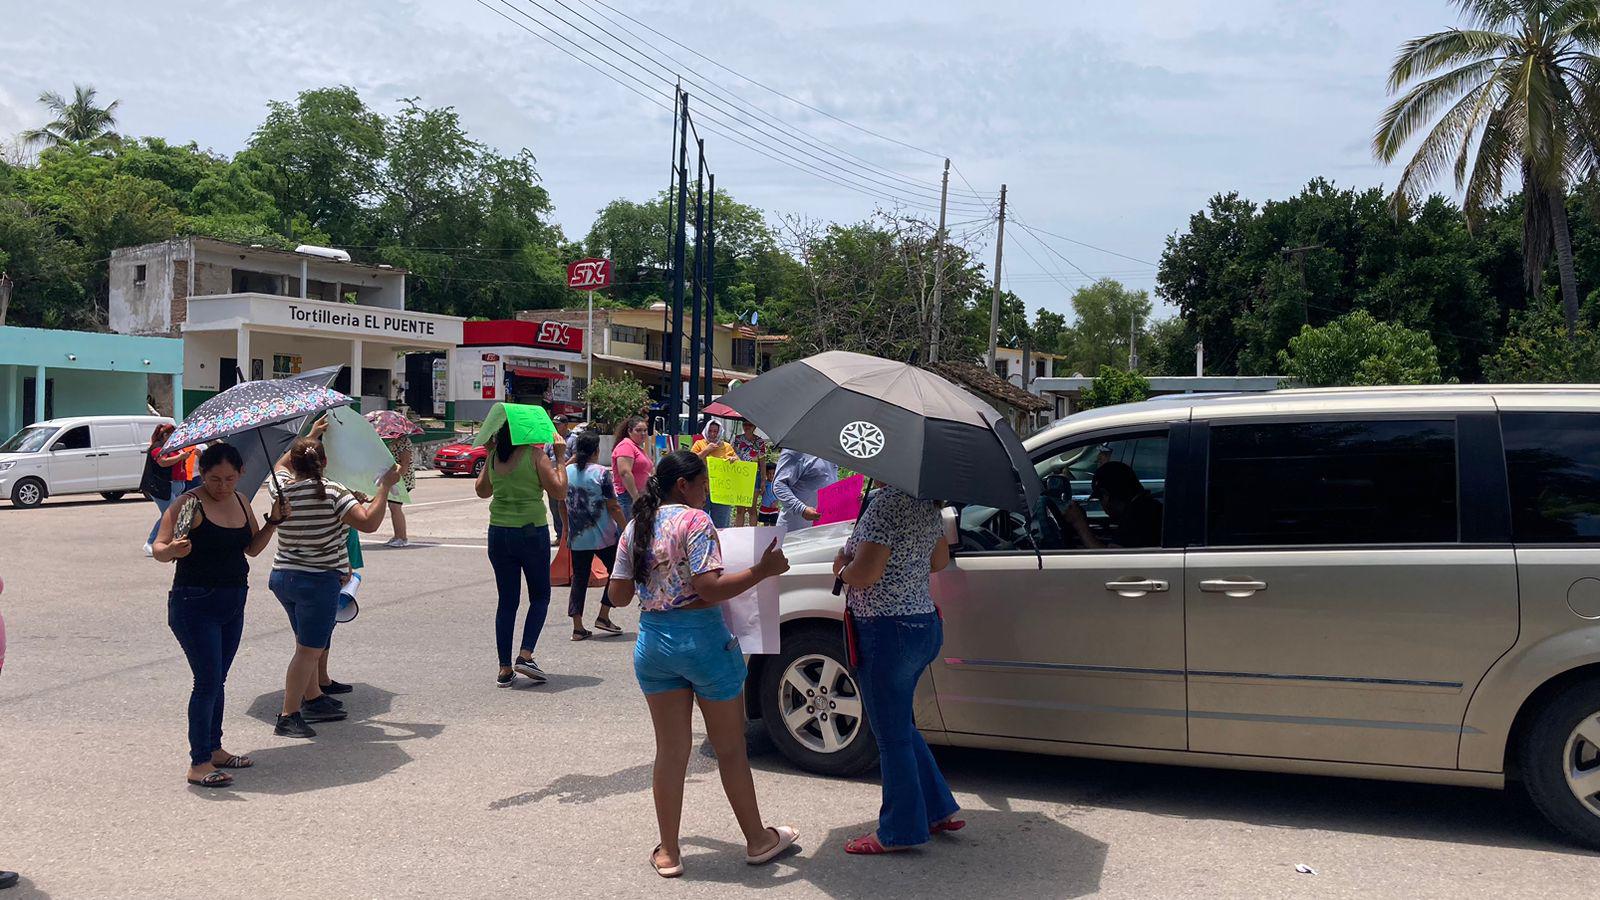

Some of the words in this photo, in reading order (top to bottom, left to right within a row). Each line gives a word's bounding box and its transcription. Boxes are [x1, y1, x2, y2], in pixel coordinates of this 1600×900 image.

[289, 306, 360, 327] Tortilleria
[365, 315, 380, 329] EL
[385, 317, 434, 334] PUENTE
